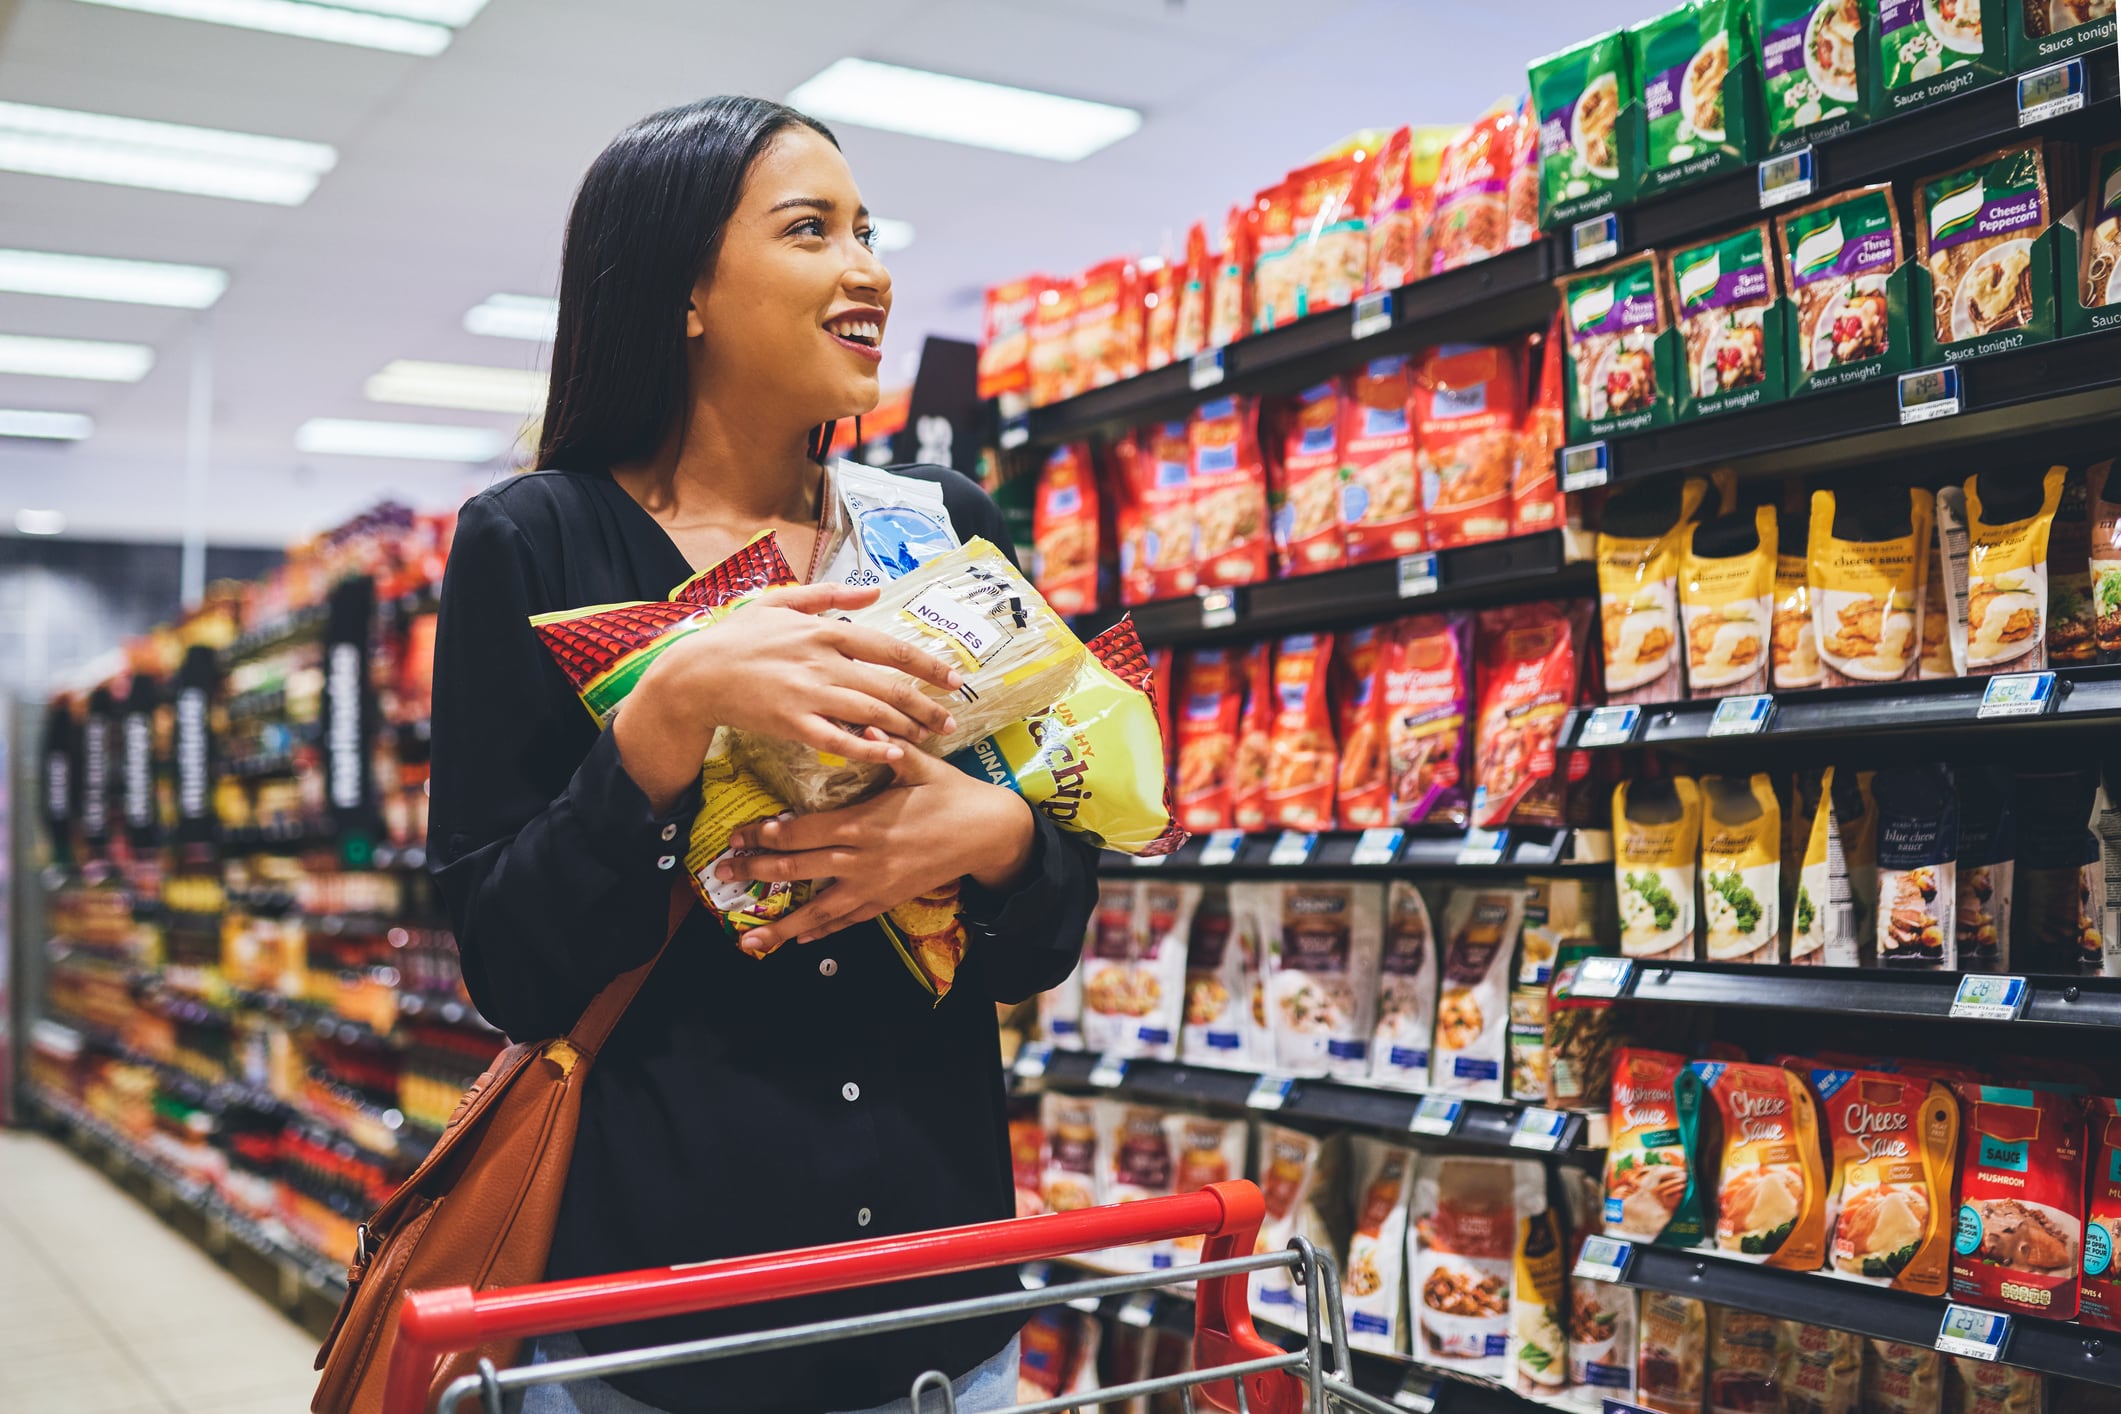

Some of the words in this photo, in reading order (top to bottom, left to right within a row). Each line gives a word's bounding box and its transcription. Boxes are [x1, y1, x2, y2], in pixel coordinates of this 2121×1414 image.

[2039, 36, 2073, 55] Sauce
[1894, 90, 1925, 108] Sauce
[1928, 72, 1974, 97] tonight?
[1779, 134, 1808, 152] Sauce
[1809, 119, 1850, 142] tonight?
[1656, 168, 1682, 184] Sauce
[1684, 153, 1721, 175] tonight?
[1989, 201, 2027, 219] Cheese
[2028, 198, 2039, 210] &
[1865, 216, 1886, 228] Sauce
[1979, 209, 2037, 232] Peppercorn
[1863, 238, 1890, 251] Three
[1857, 248, 1892, 265] Cheese
[1732, 281, 1765, 297] Cheese
[2092, 313, 2121, 328] Sauc
[1945, 346, 1975, 361] Sauce
[1978, 334, 2024, 354] tonight?
[1810, 374, 1838, 389] Sauce
[1840, 363, 1882, 384] tonight?
[1698, 400, 1723, 415] Sauce
[1725, 390, 1760, 409] tonight?
[1617, 414, 1652, 430] tonight?
[1834, 555, 1874, 567] cheese
[1880, 555, 1914, 565] sauce
[1056, 702, 1095, 758] UNHY
[1023, 706, 1093, 825] achip
[1885, 829, 1906, 841] blue
[1909, 830, 1936, 842] cheese
[1897, 843, 1924, 852] sauce
[1700, 1063, 1715, 1082] NEW
[1817, 1071, 1838, 1092] NEW
[1614, 1083, 1673, 1107] Mushroom
[1729, 1090, 1786, 1121] Cheese
[1620, 1105, 1668, 1133] Sauce
[1844, 1103, 1909, 1135] Cheese
[1734, 1119, 1786, 1148] Sauce
[1858, 1134, 1910, 1165] Sauce
[1986, 1147, 2021, 1164] SAUCE
[1977, 1172, 2025, 1188] MUSHROOM
